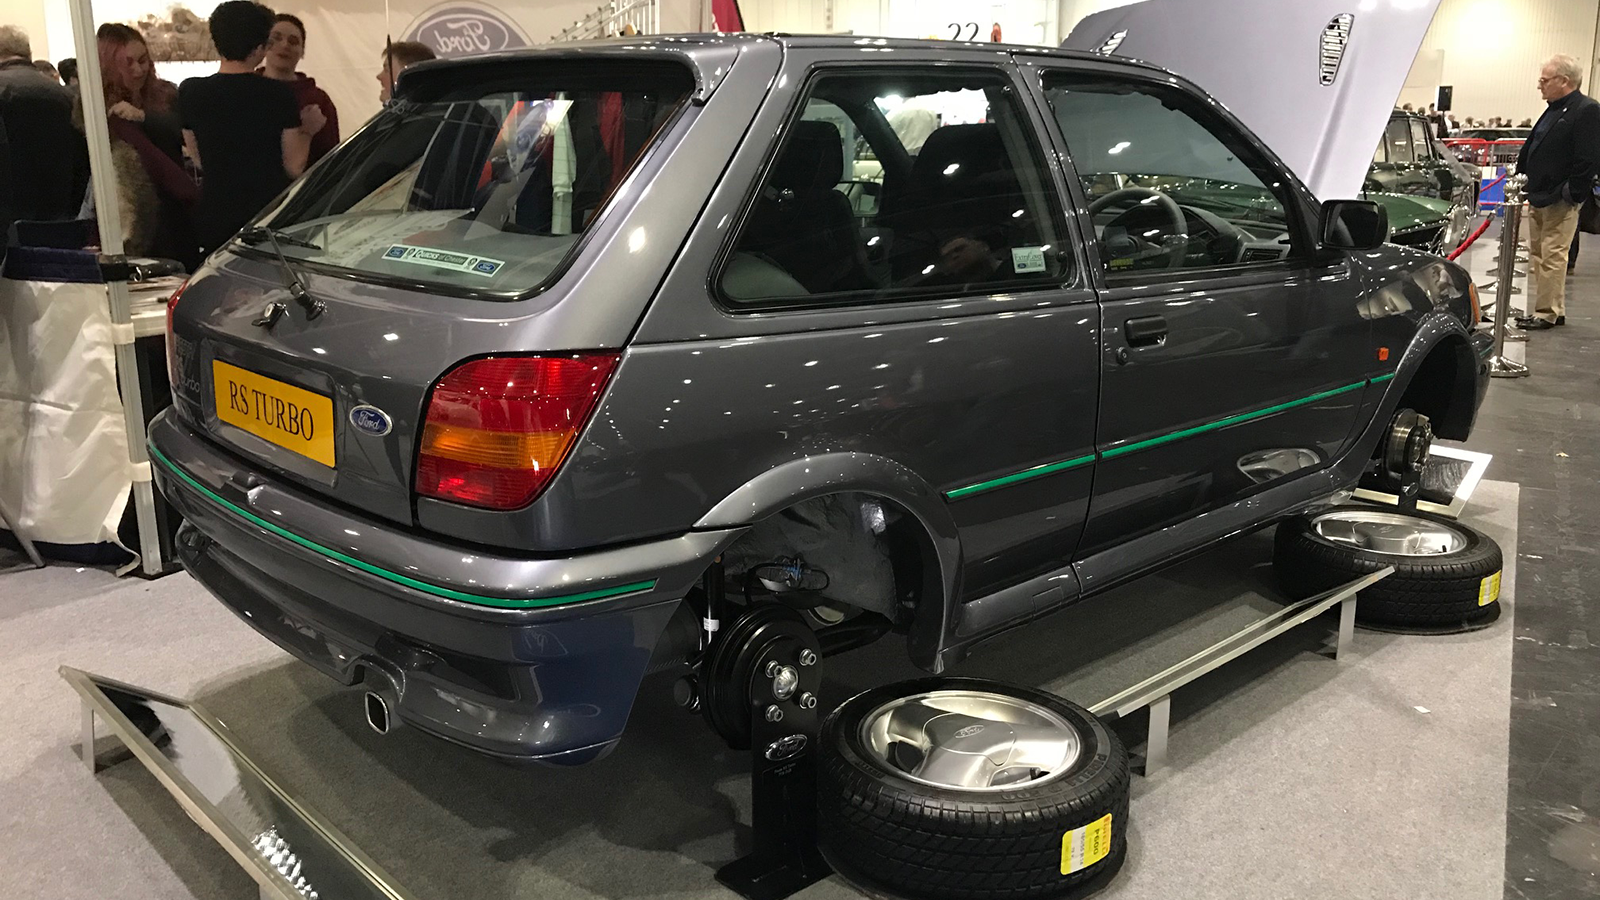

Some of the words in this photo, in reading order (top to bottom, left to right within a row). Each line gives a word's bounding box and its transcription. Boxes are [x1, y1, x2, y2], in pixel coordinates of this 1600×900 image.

[947, 22, 979, 41] 22
[228, 380, 249, 416] RS
[252, 389, 315, 441] TURBO
[357, 410, 381, 432] Ford
[1093, 828, 1101, 856] P600
